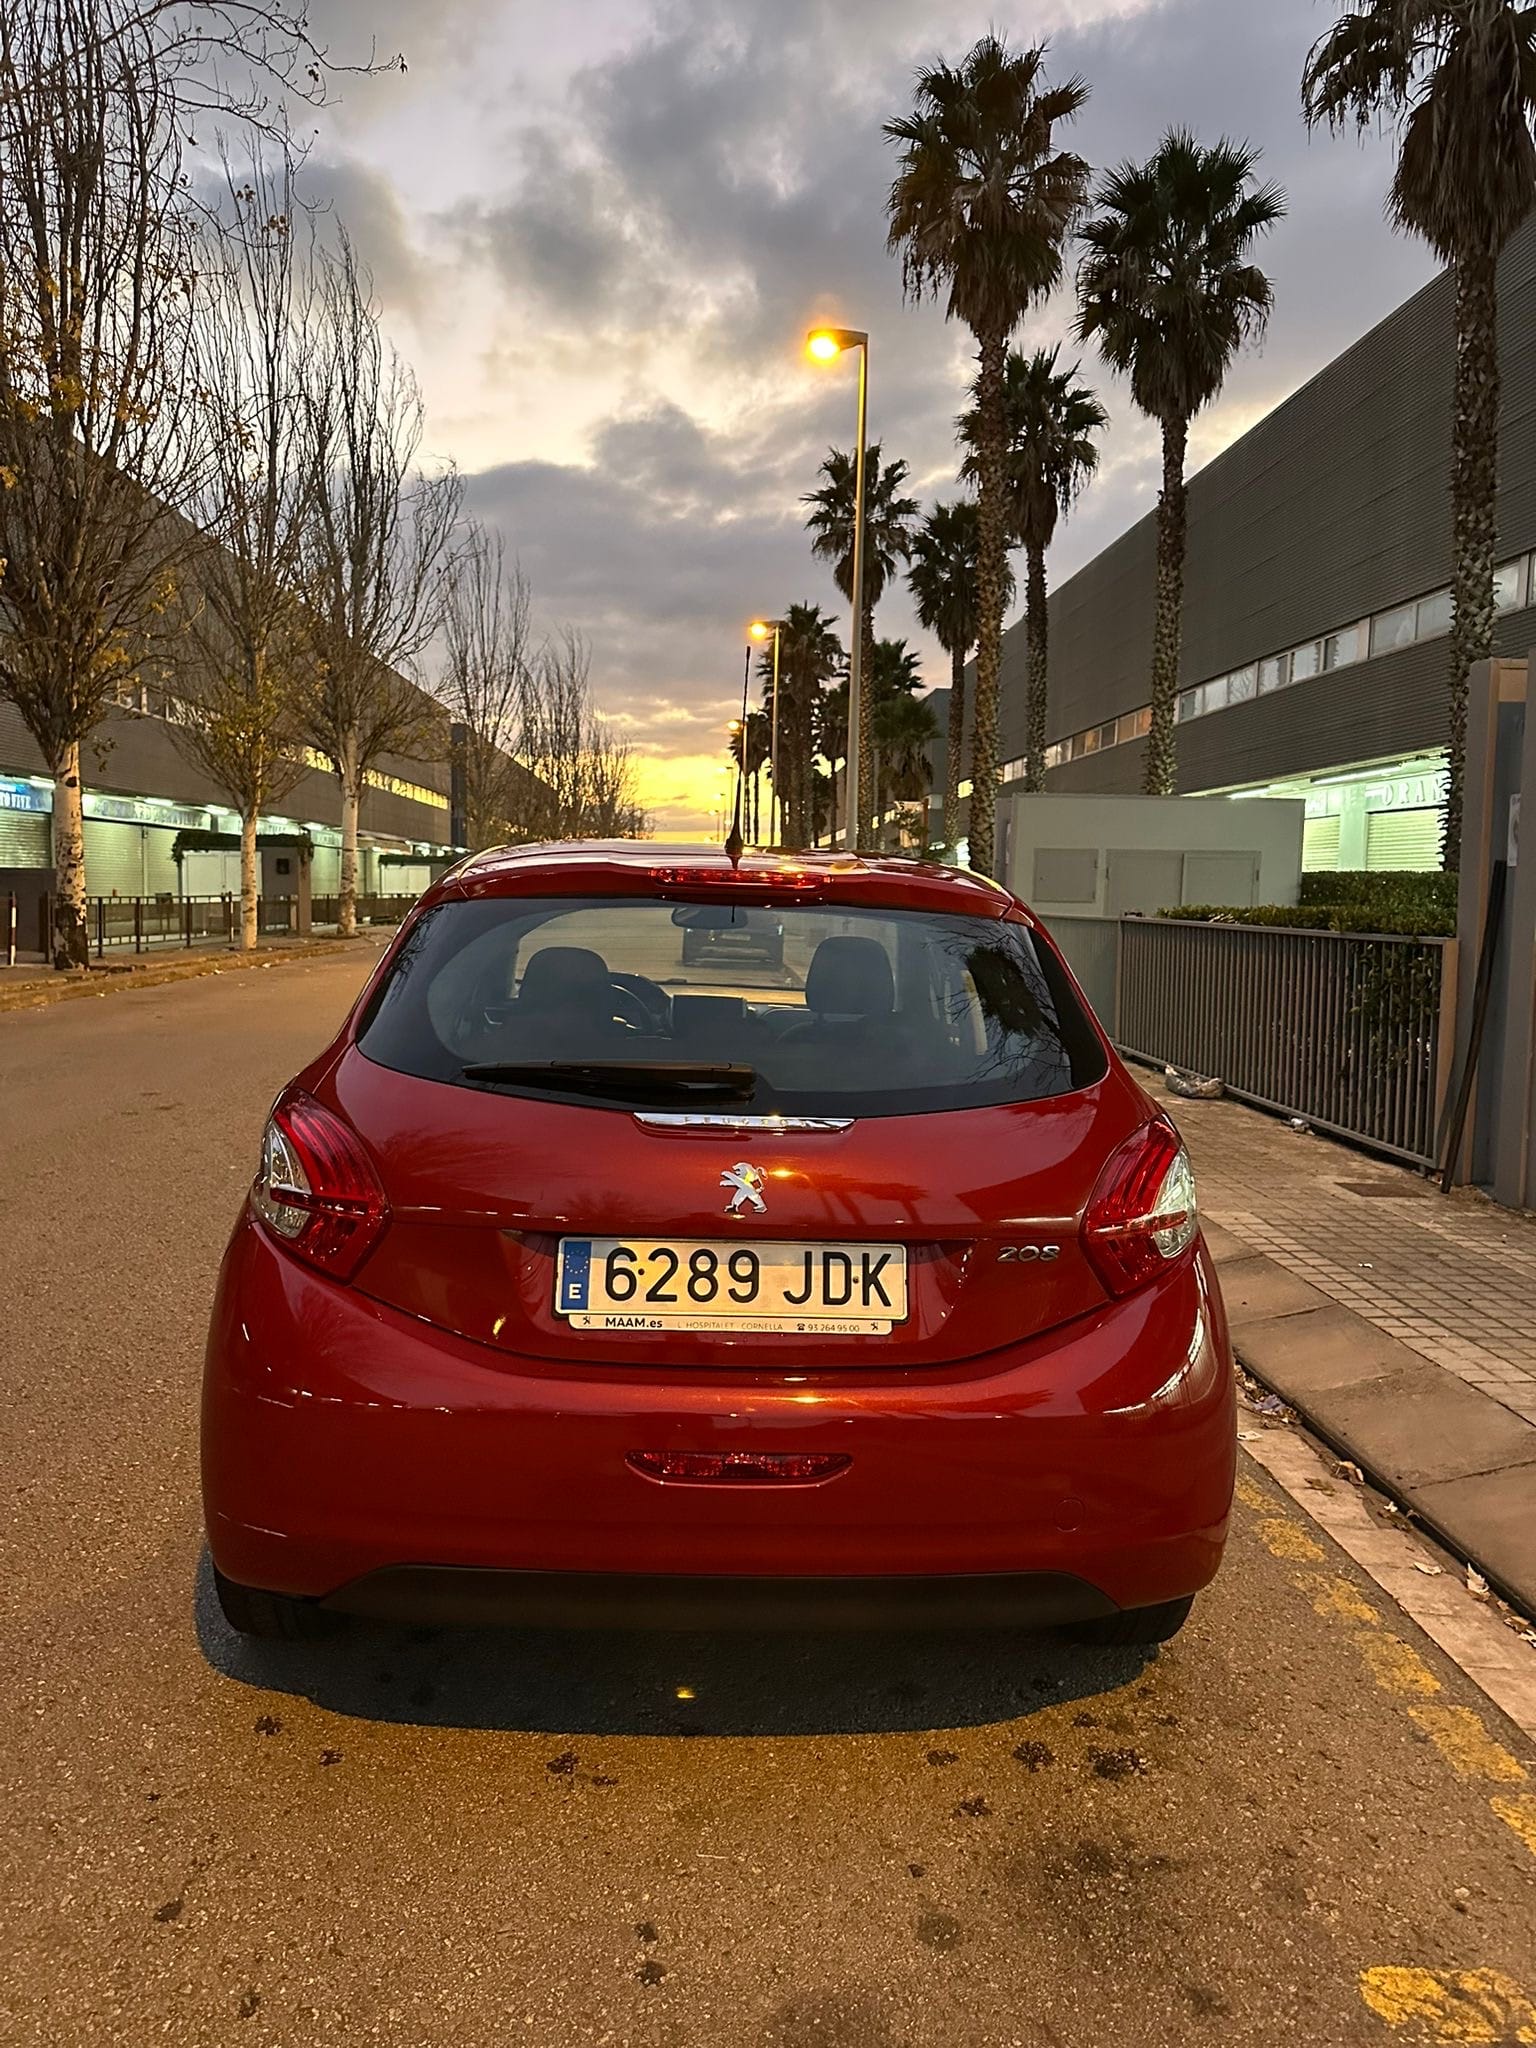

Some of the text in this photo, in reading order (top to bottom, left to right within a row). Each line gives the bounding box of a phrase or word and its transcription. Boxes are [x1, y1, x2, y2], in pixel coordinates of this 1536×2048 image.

[997, 1245, 1060, 1262] 208
[605, 1247, 892, 1307] 6289 JDK
[569, 1283, 582, 1299] E
[605, 1317, 663, 1329] MAAM.es
